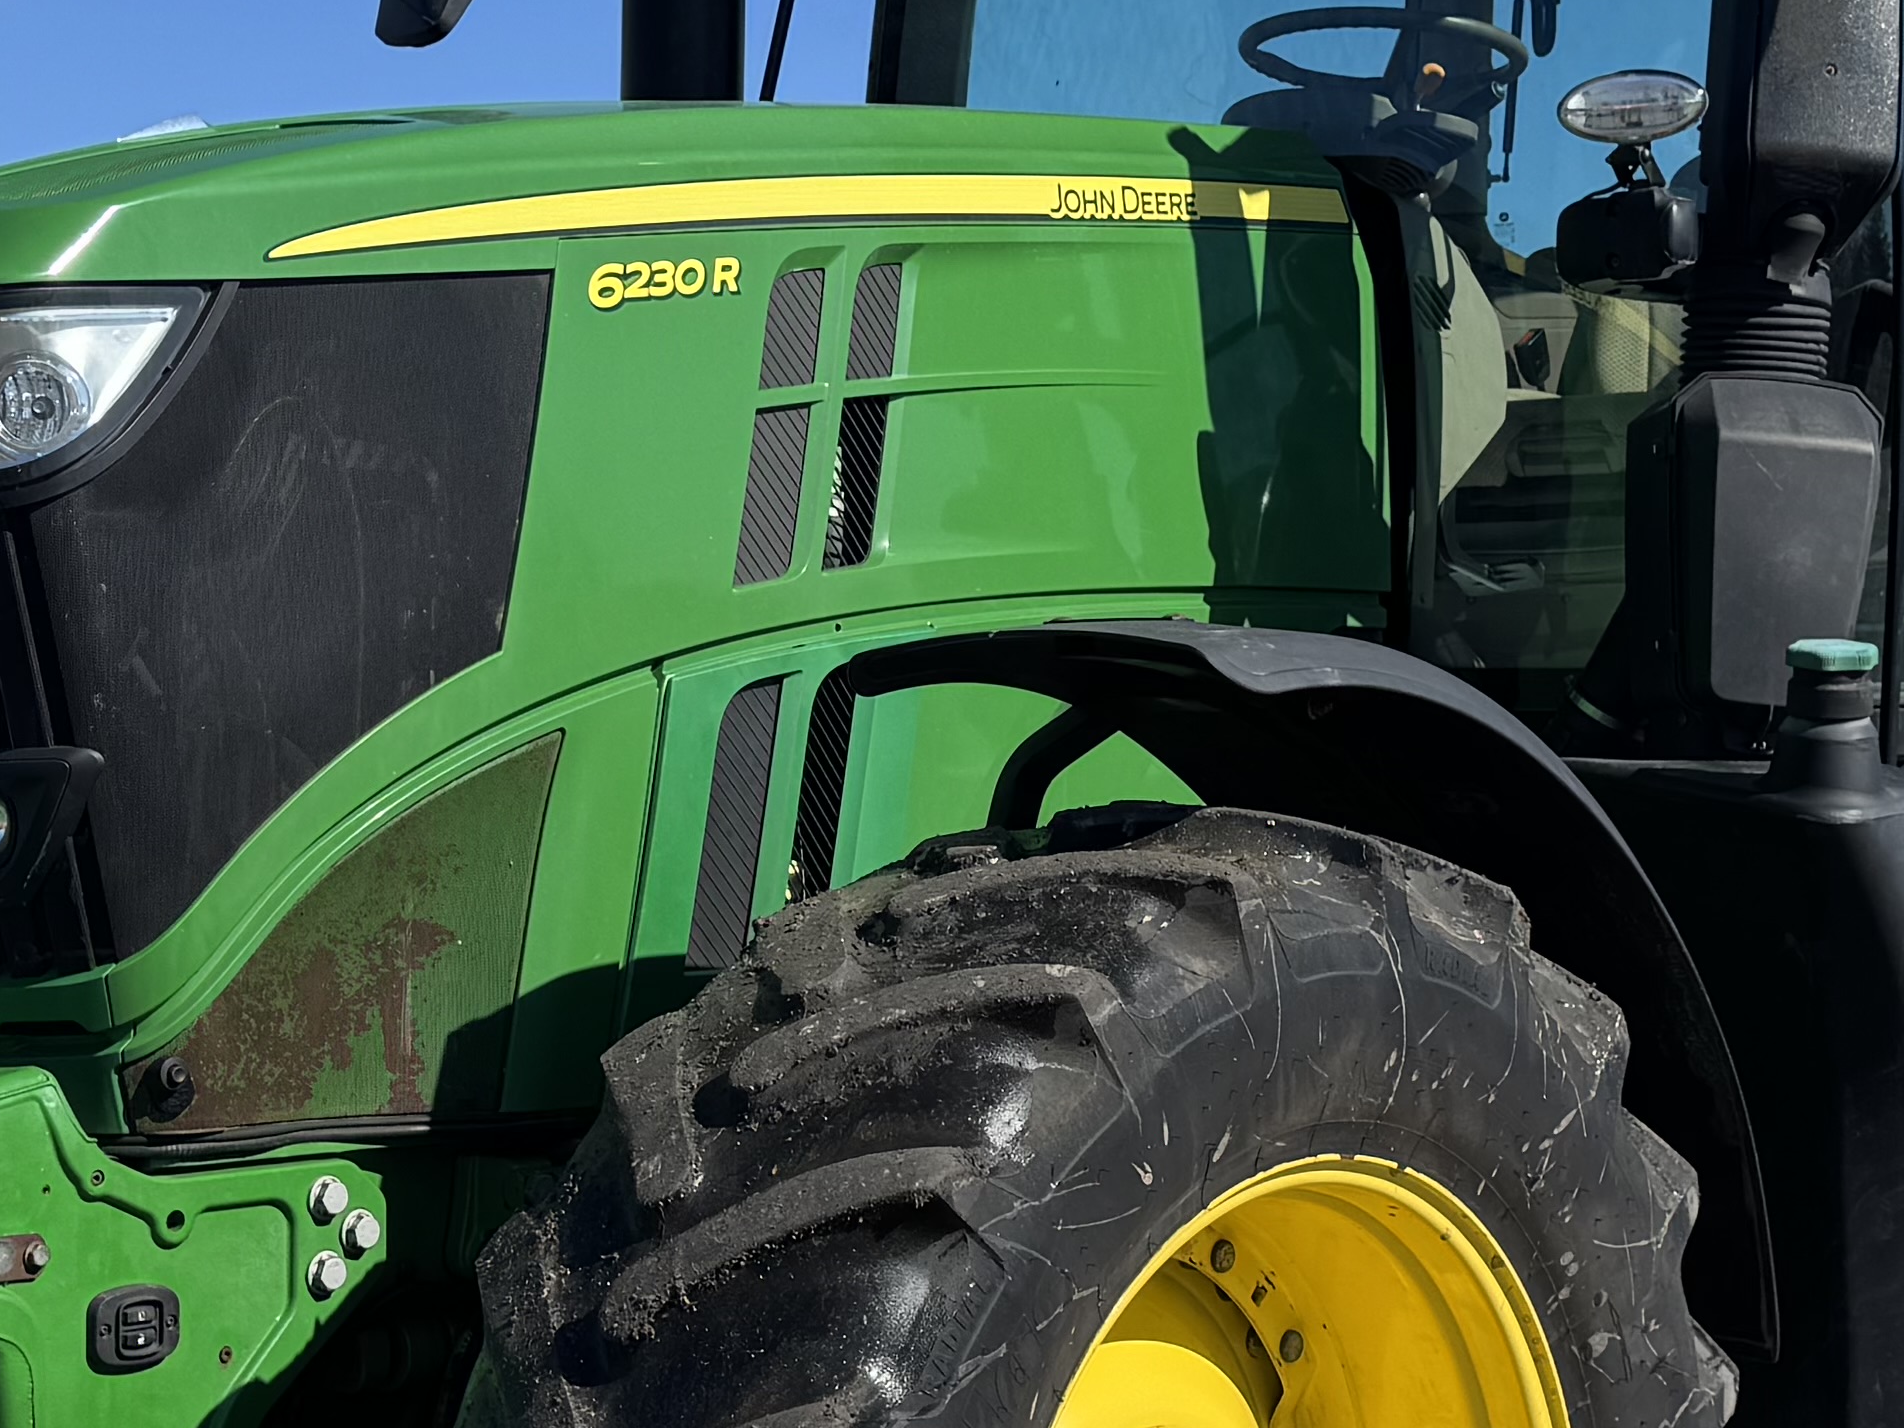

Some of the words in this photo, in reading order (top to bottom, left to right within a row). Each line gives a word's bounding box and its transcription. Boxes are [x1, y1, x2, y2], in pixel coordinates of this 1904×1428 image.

[1050, 182, 1116, 215] JOHN
[1121, 185, 1198, 217] DEERE
[588, 257, 707, 311] 6230
[711, 255, 741, 294] R
